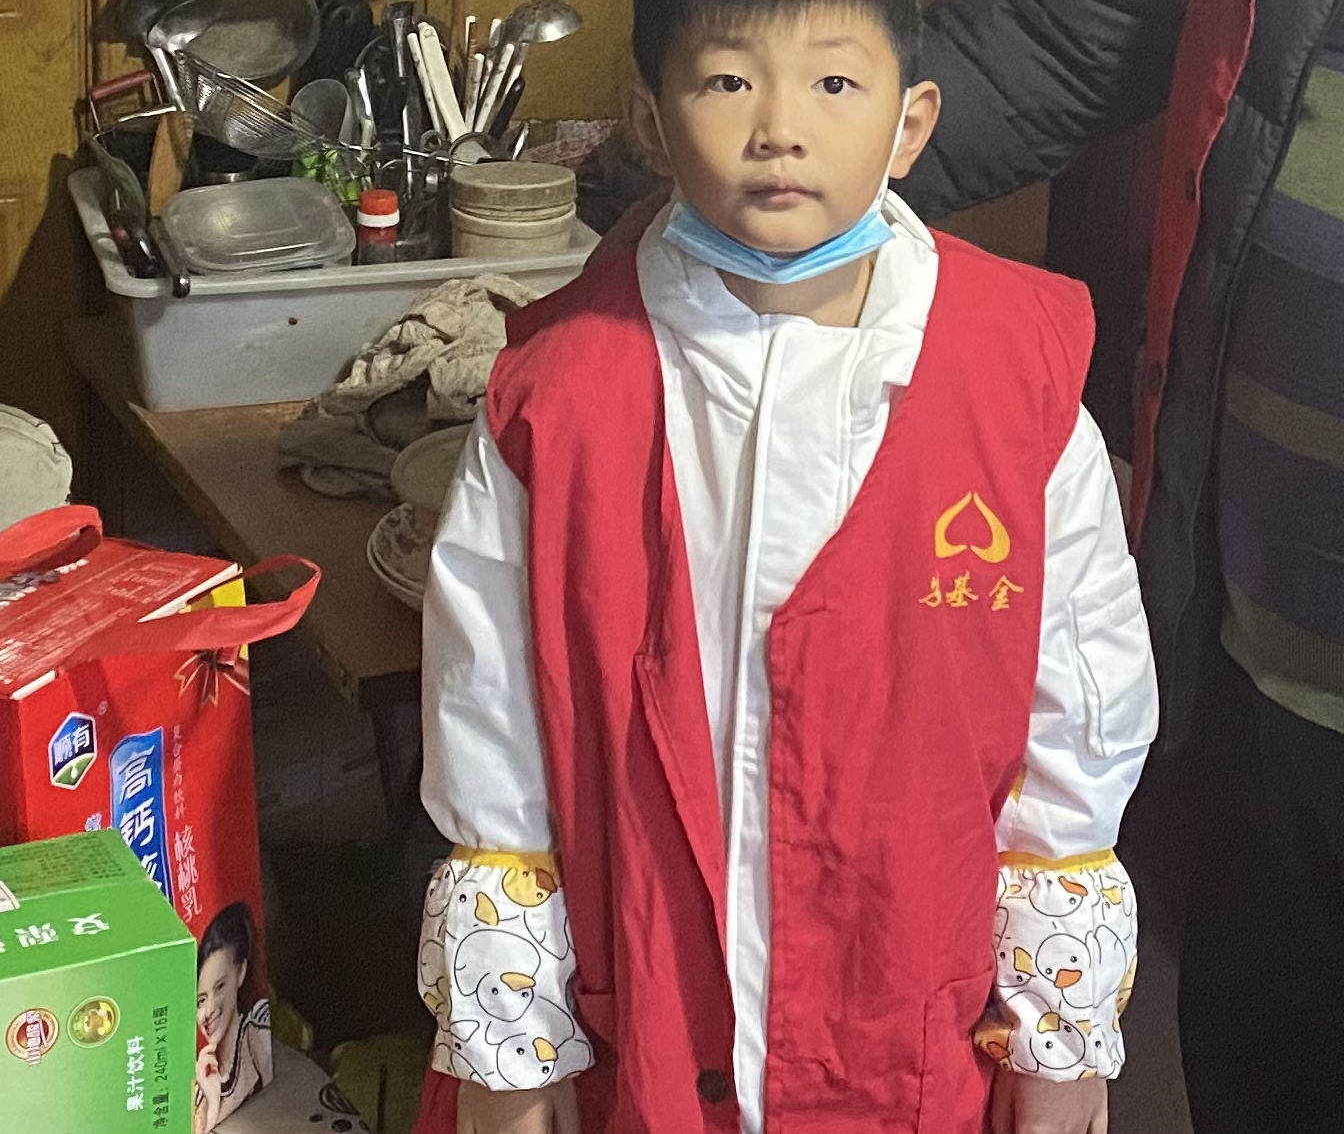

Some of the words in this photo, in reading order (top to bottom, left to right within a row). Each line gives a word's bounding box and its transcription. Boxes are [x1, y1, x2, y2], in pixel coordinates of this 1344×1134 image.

[173, 825, 203, 922] 核桃乳
[126, 1035, 145, 1112] 果汁饮料
